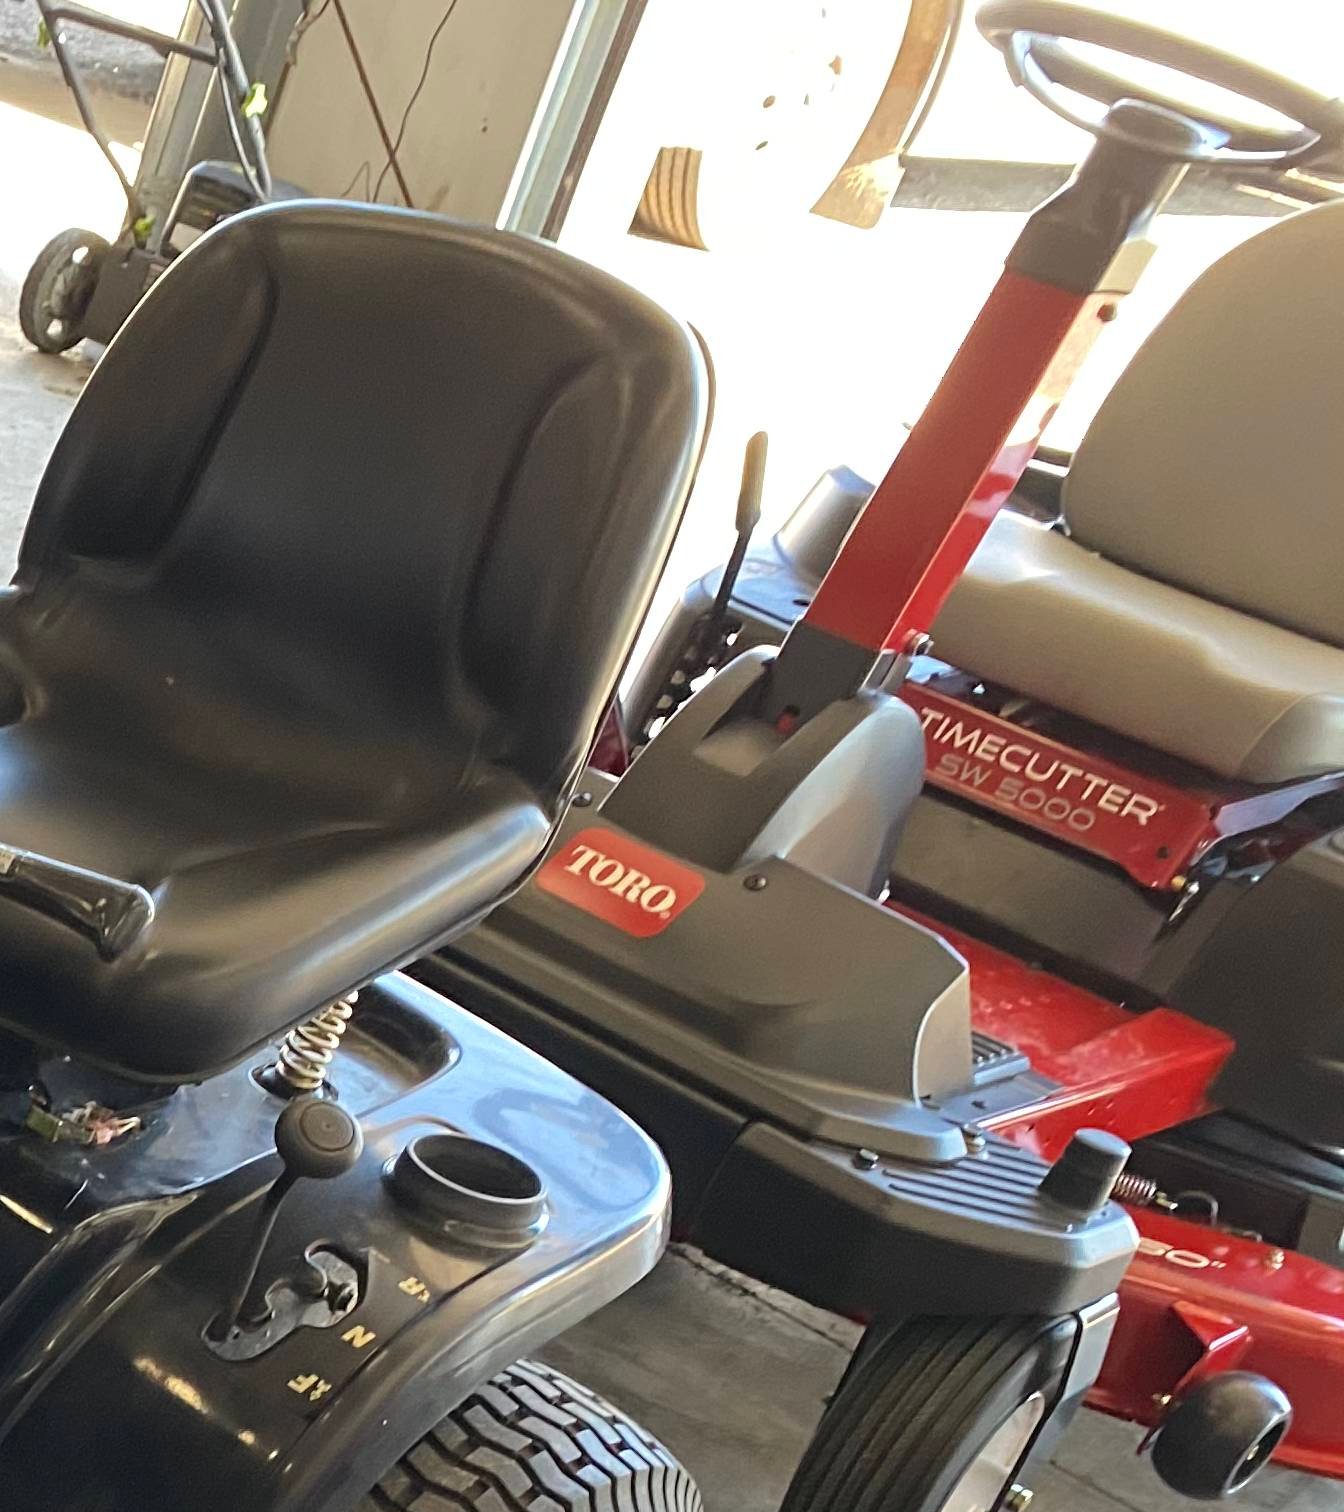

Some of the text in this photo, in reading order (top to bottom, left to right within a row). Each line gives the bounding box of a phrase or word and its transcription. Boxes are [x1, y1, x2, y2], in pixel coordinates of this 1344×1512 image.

[920, 706, 1160, 826] TIMECUTTER
[936, 753, 1096, 831] SW 5000
[564, 845, 676, 913] TORO
